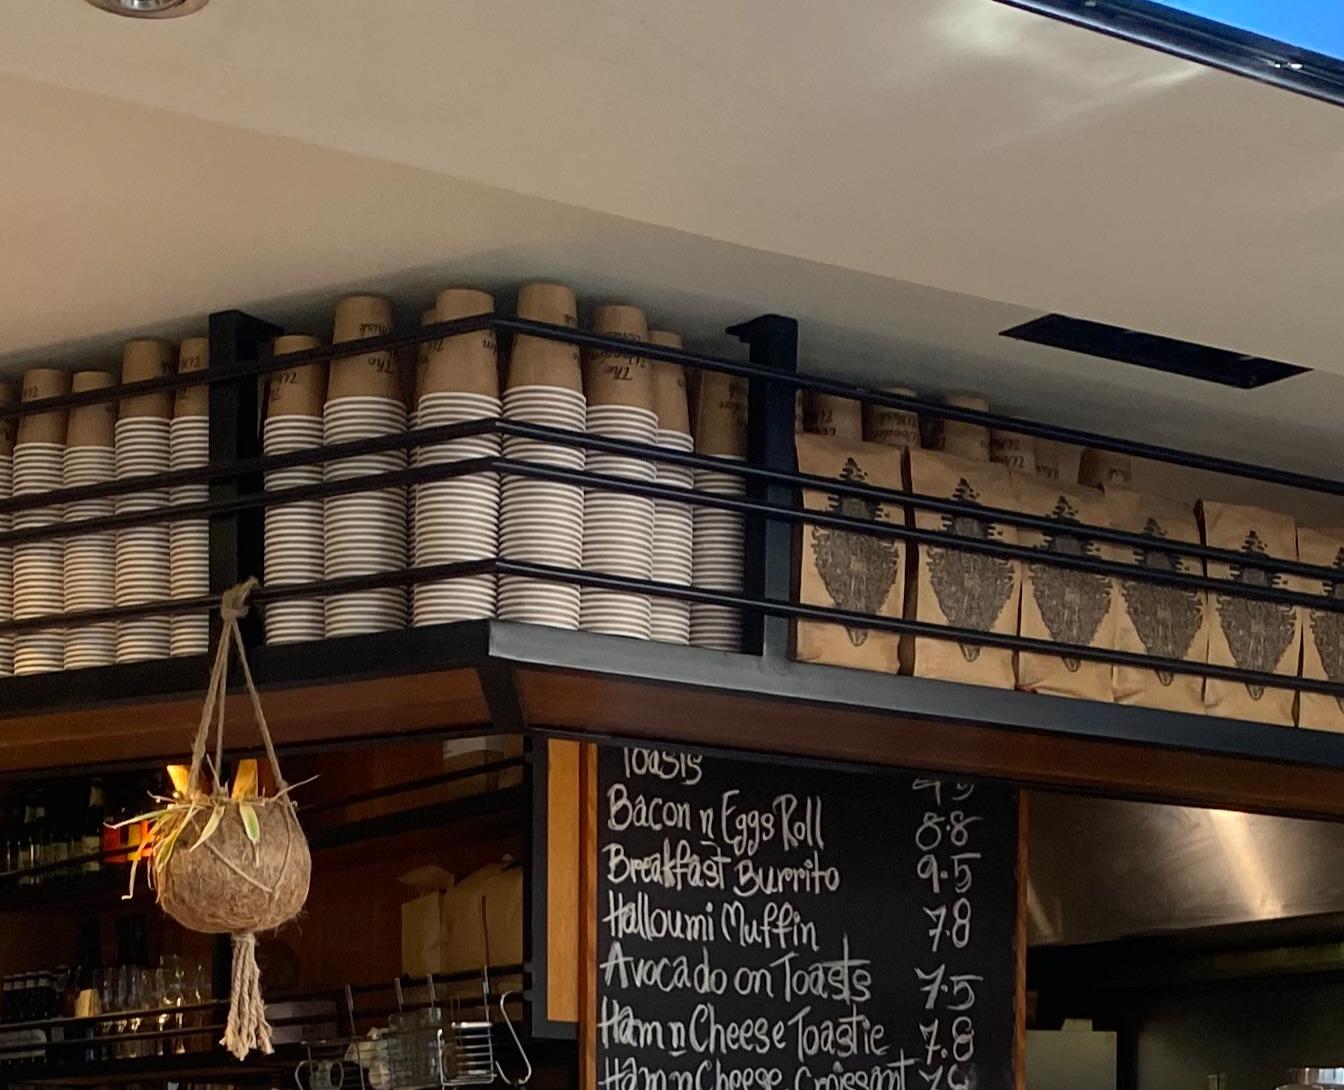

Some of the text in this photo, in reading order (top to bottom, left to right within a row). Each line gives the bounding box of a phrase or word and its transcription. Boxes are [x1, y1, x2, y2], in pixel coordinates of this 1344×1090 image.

[607, 783, 824, 856] Bacon n Eggs Roll
[915, 810, 983, 851] 8.8
[601, 837, 840, 897] Breakfast Burrito
[917, 853, 982, 894] 9.5
[602, 889, 820, 951] Halloumi Muffin
[599, 941, 727, 995] Avocado
[734, 967, 774, 998] on
[914, 964, 984, 1010] 7.5
[597, 996, 664, 1050] Ham
[689, 1002, 786, 1055] Cheese
[788, 1003, 892, 1063] Toastie
[919, 1016, 975, 1065] 7.8
